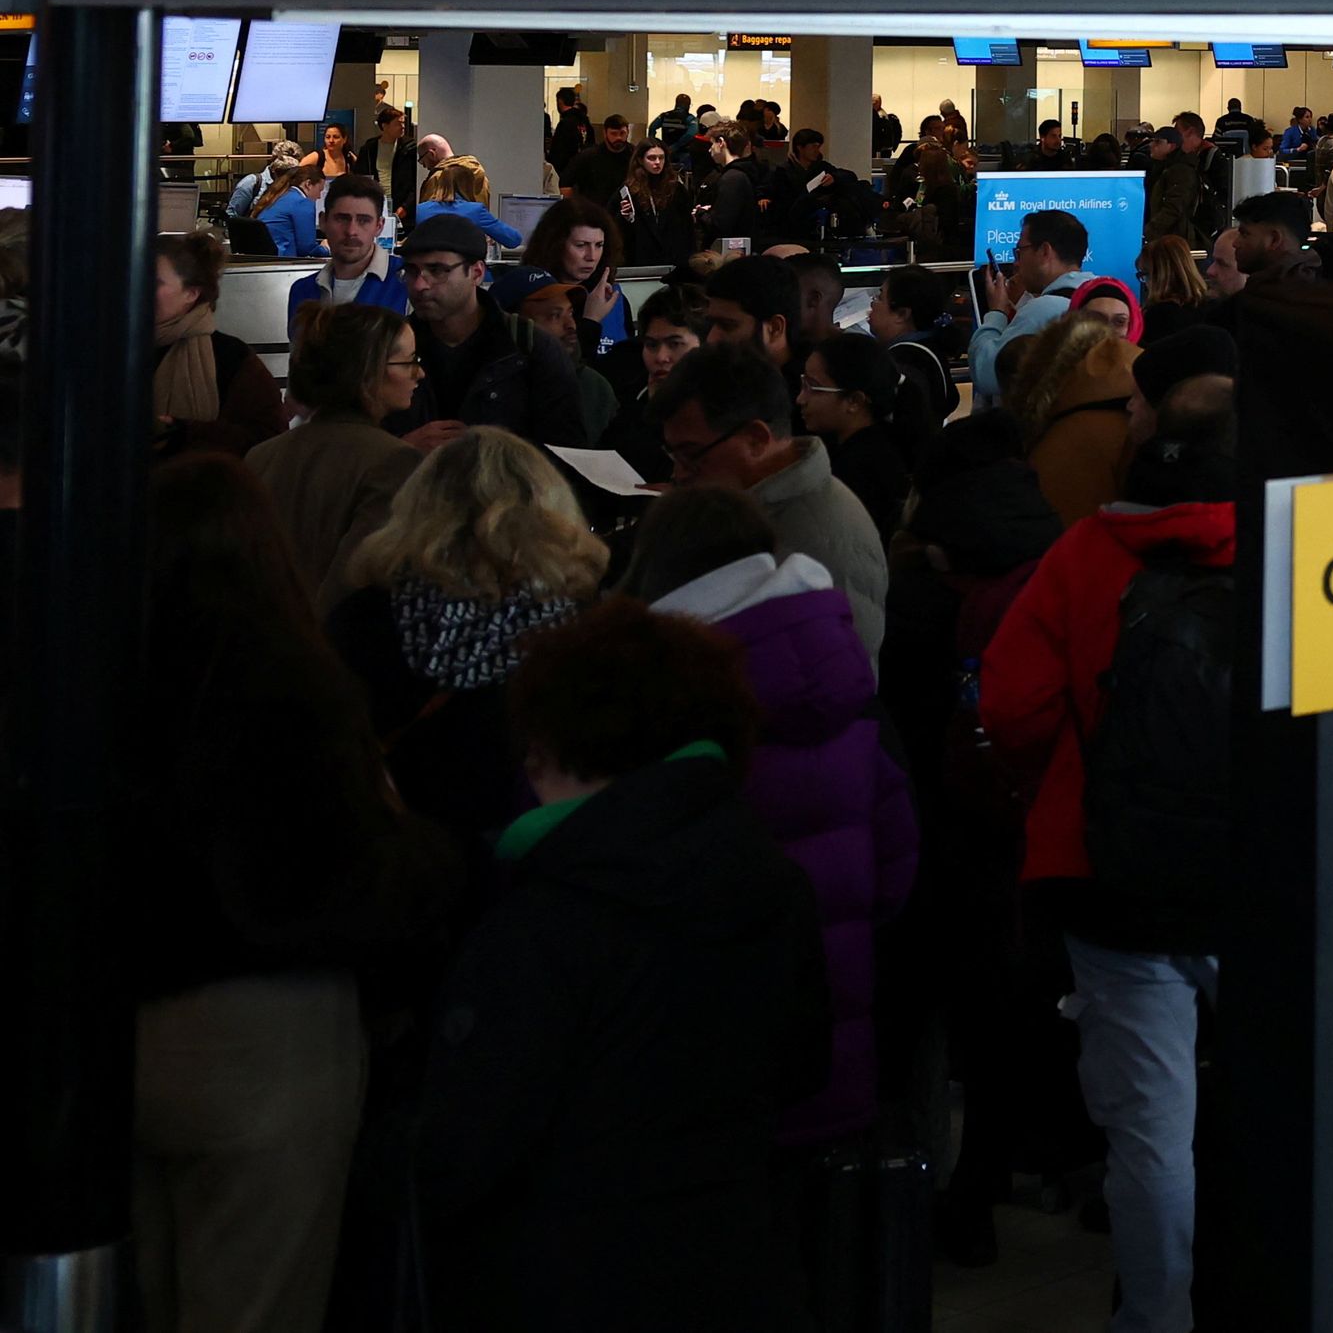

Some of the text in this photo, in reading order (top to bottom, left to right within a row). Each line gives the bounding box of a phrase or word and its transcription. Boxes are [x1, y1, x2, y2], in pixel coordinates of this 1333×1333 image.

[742, 35, 773, 45] Baggage
[988, 199, 1112, 212] KLM Royal Dutch Airlines
